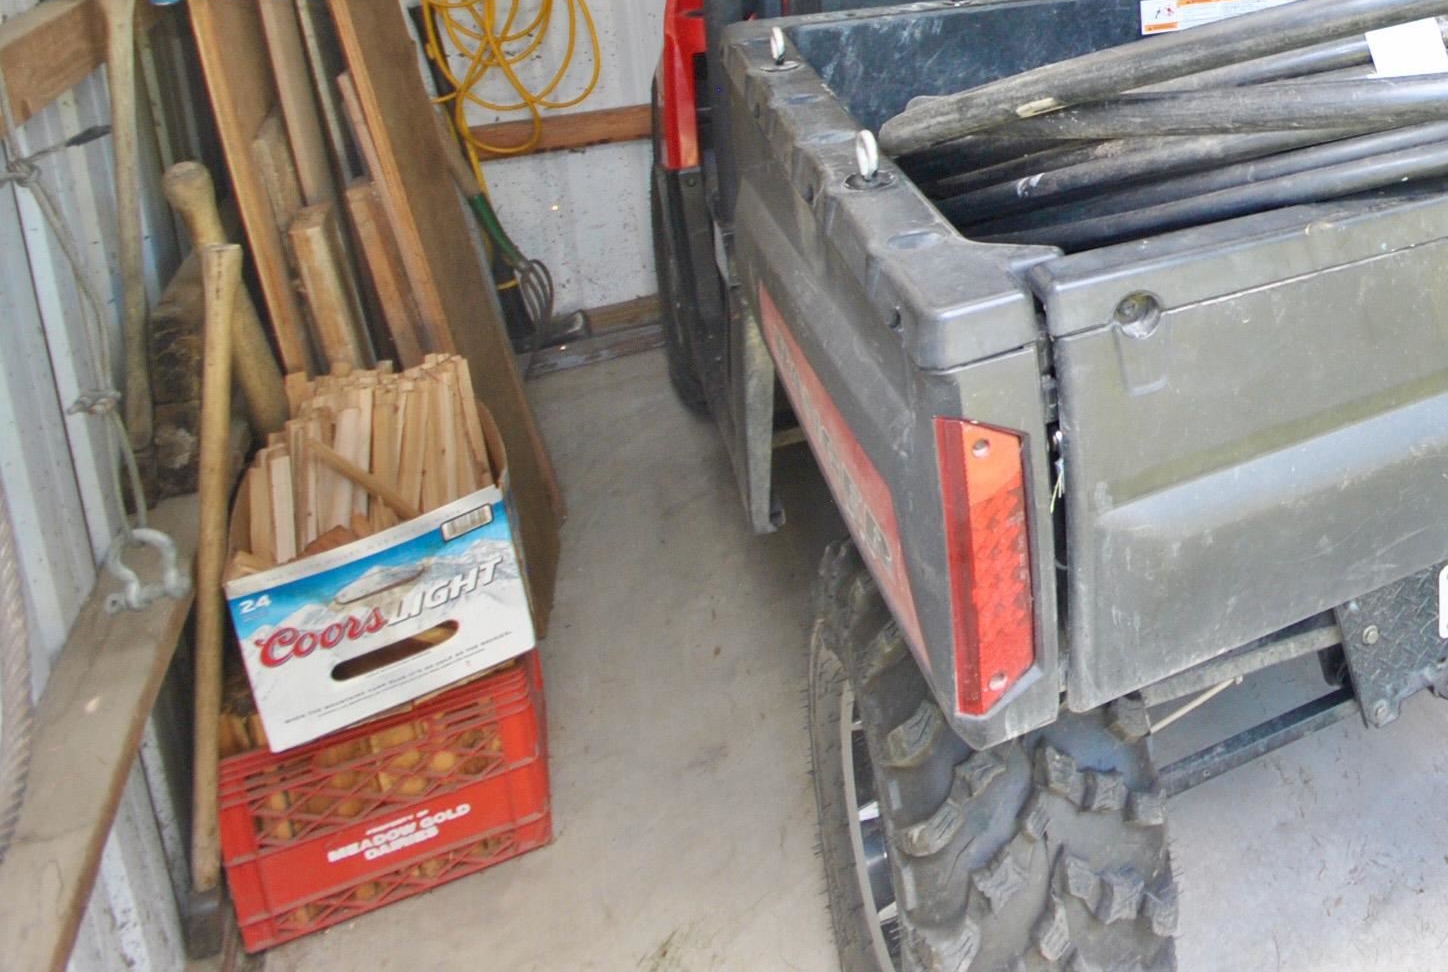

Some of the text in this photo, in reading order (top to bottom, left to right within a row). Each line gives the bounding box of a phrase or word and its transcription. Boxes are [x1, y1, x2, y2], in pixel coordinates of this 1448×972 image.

[239, 594, 272, 614] 24
[254, 607, 388, 668] Coors
[388, 557, 503, 627] LIGHT
[327, 803, 471, 862] MEADOW GOLD
